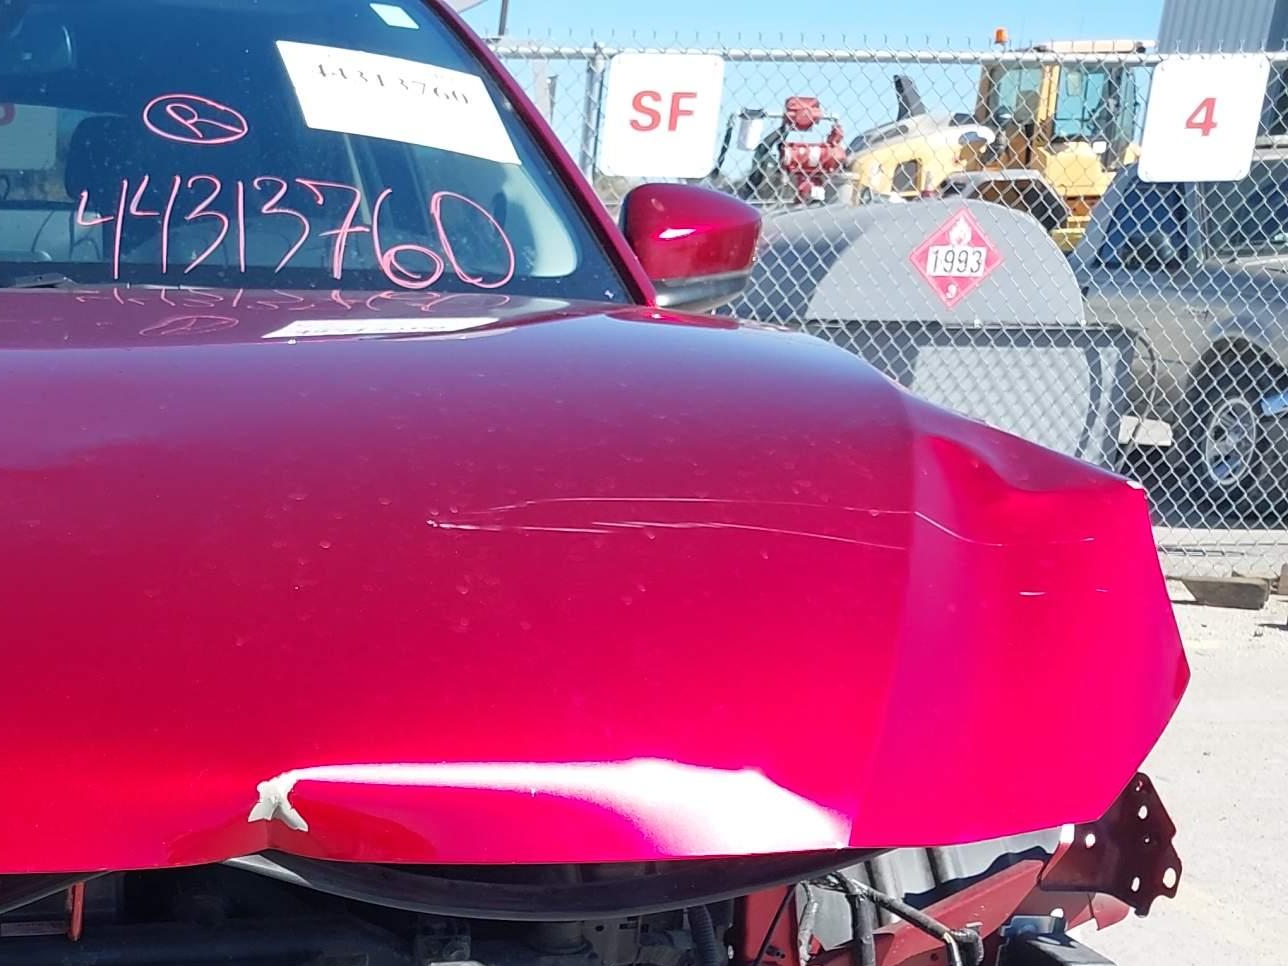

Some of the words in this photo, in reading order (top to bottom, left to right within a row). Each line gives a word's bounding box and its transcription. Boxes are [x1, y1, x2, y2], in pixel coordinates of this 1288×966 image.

[629, 90, 697, 132] SF
[1184, 97, 1218, 137] 4
[75, 174, 515, 289] 44313760
[932, 249, 982, 273] 1993
